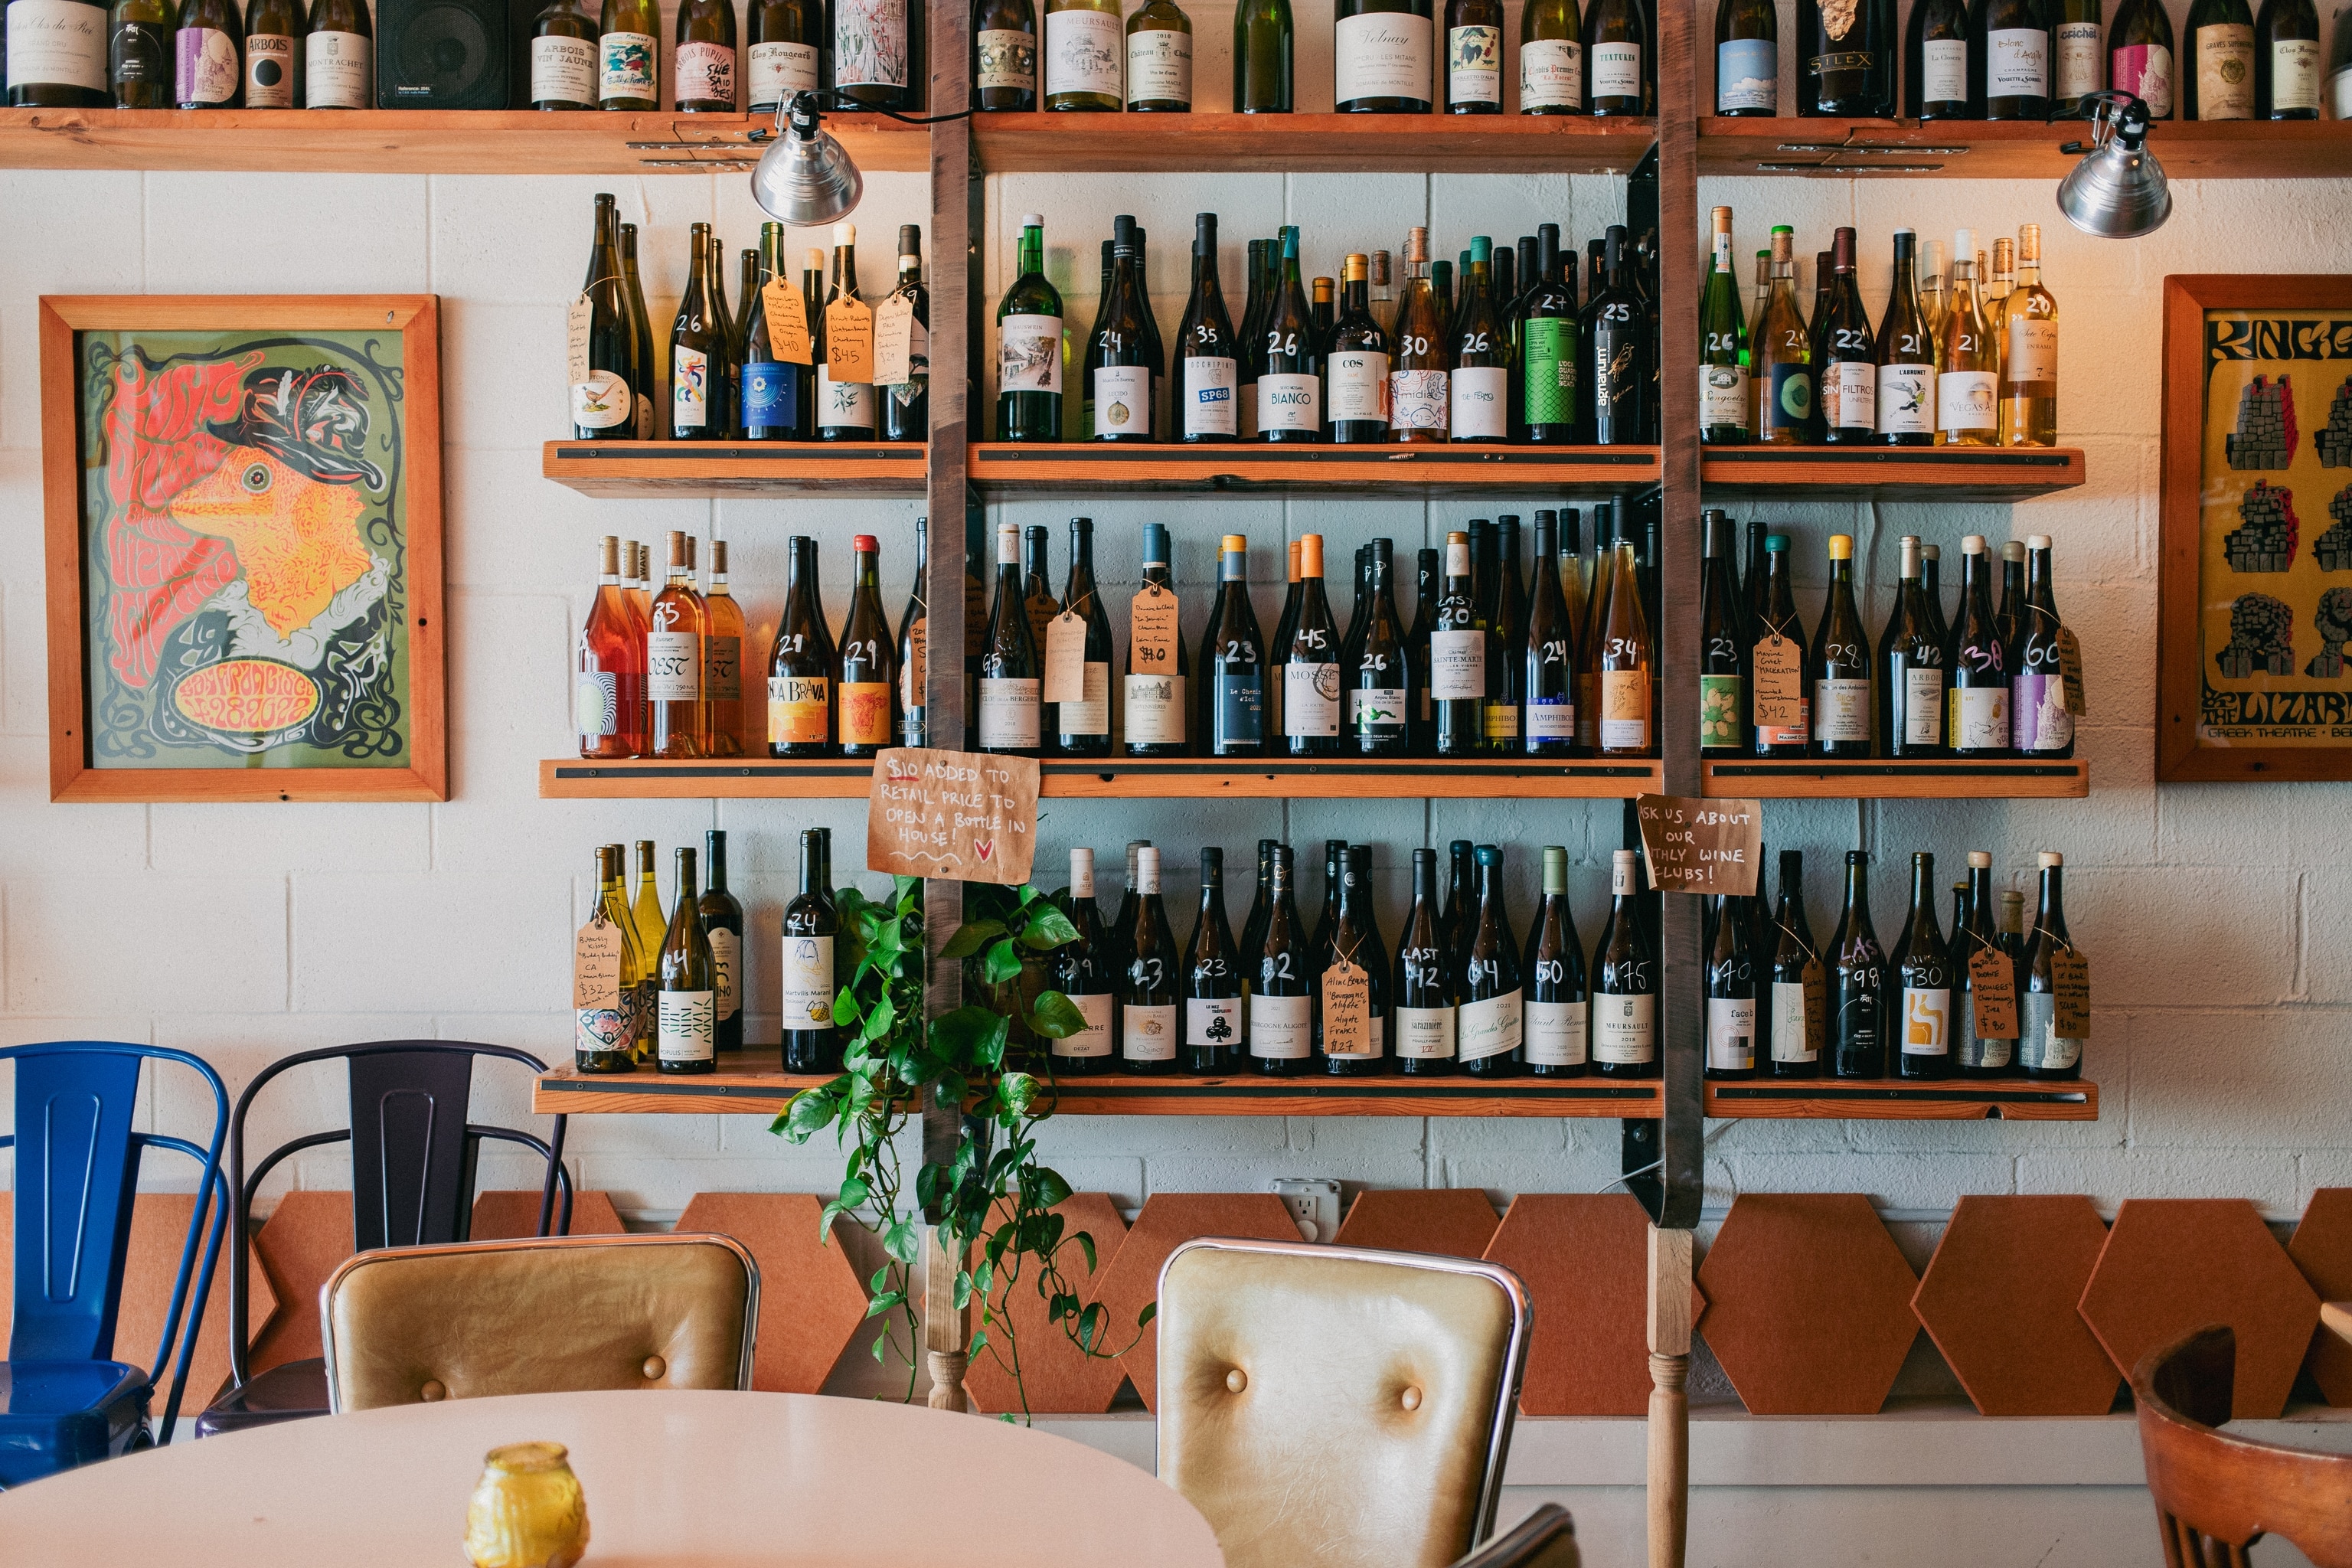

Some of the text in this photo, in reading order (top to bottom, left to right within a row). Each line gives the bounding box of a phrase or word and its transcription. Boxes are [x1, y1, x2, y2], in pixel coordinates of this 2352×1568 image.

[53, 18, 93, 35] du Roi
[1066, 17, 1119, 31] MEURSAULT
[249, 38, 289, 52] ARBOIS
[544, 44, 586, 57] ARBOIS
[1998, 38, 2024, 49] Blanc
[2207, 42, 2226, 51] GRAVES
[2279, 45, 2295, 55] Clos
[537, 54, 594, 69] VIN JAUNE
[677, 48, 696, 73] ARBOIS
[751, 47, 811, 60] Clos Rougeard
[1129, 49, 1154, 60] Château
[1599, 53, 1635, 63] TEXTURES
[1941, 54, 1962, 62] Closerie
[309, 59, 364, 70] MONTRACHET
[706, 64, 730, 78] SHE
[1550, 64, 1573, 74] Premier
[707, 77, 731, 89] SAID
[1998, 75, 2021, 84] VOUETTE
[710, 87, 734, 102] YES!
[1541, 294, 1567, 310] 27
[2026, 296, 2050, 315] 20
[1603, 303, 1630, 322] 25
[675, 314, 702, 335] 26
[1099, 330, 1122, 353] 24
[1195, 325, 1218, 344] 35
[1361, 330, 1380, 348] 29
[1708, 332, 1734, 352] 26
[1836, 332, 1867, 354] 22
[2207, 320, 2332, 361] KING
[773, 335, 799, 354] $40
[1267, 330, 1297, 358] 26
[1400, 335, 1427, 358] 30
[1462, 332, 1488, 356] 26
[1900, 335, 1921, 355] 21
[1958, 335, 1978, 355] 21
[831, 345, 860, 365] $45
[879, 351, 896, 365] $29
[1342, 358, 1364, 369] COS
[764, 367, 780, 376] LONG
[1191, 360, 1236, 370] OCCHIPINTI
[2036, 368, 2043, 377] 7
[1597, 348, 1608, 407] agnanum
[1108, 389, 1129, 397] LUCIDO
[1200, 389, 1229, 403] SP68
[1472, 390, 1494, 402] FERMO
[1822, 384, 1838, 395] SIN
[1271, 393, 1312, 405] BIANCO
[1950, 400, 1980, 413] VEGAS
[1438, 596, 1475, 609] LAST
[1440, 607, 1469, 624] 20
[779, 634, 804, 657] 29
[1298, 629, 1328, 650] 45
[847, 639, 877, 670] 29
[1224, 640, 1256, 665] 23
[1543, 639, 1567, 666] 24
[1609, 639, 1637, 665] 34
[1710, 638, 1737, 662] 23
[1828, 644, 1862, 669] 28
[1916, 644, 1943, 665] 42
[1964, 639, 2004, 672] 38
[982, 653, 1002, 672] 65
[1359, 653, 1387, 672] 26
[215, 662, 315, 697] FRANCISCO
[1289, 671, 1337, 684] MOSSE
[789, 680, 825, 703] BRAVA
[1758, 702, 1789, 720] $42
[2208, 727, 2318, 738] GREEK THEATRE
[887, 757, 1010, 784] $10 ADDED TO
[880, 783, 1015, 809] RETAIL PRICE TO
[885, 808, 926, 825] OPEN
[933, 812, 944, 828] A
[1008, 819, 1026, 833] IN
[1665, 808, 1683, 825] US
[1695, 810, 1751, 826] ABOUT
[1665, 831, 1696, 845] OUR
[1699, 848, 1745, 864] WINE
[1654, 865, 1713, 885] CLUBS!
[791, 913, 816, 936] 24
[1402, 947, 1439, 962] LAST
[1067, 957, 1093, 978] 29
[1132, 957, 1164, 991] 23
[1201, 958, 1227, 978] 23
[1262, 952, 1295, 985] 32
[1468, 959, 1499, 989] 64
[1536, 960, 1563, 985] 50
[1914, 965, 1942, 987] 30
[1325, 975, 1346, 988] Aline
[1854, 967, 1880, 988] 98
[579, 982, 606, 1000] $32
[1529, 1017, 1555, 1027] Saint
[1730, 1009, 1749, 1018] face
[1251, 1019, 1281, 1030] BOURGOGNE
[1329, 1026, 1358, 1036] France
[1471, 1023, 1498, 1040] Grandes
[1992, 1021, 2006, 1031] 80
[660, 1047, 681, 1057] POPULIS
[1136, 1044, 1165, 1055] Quincy
[1331, 1038, 1354, 1053] $27
